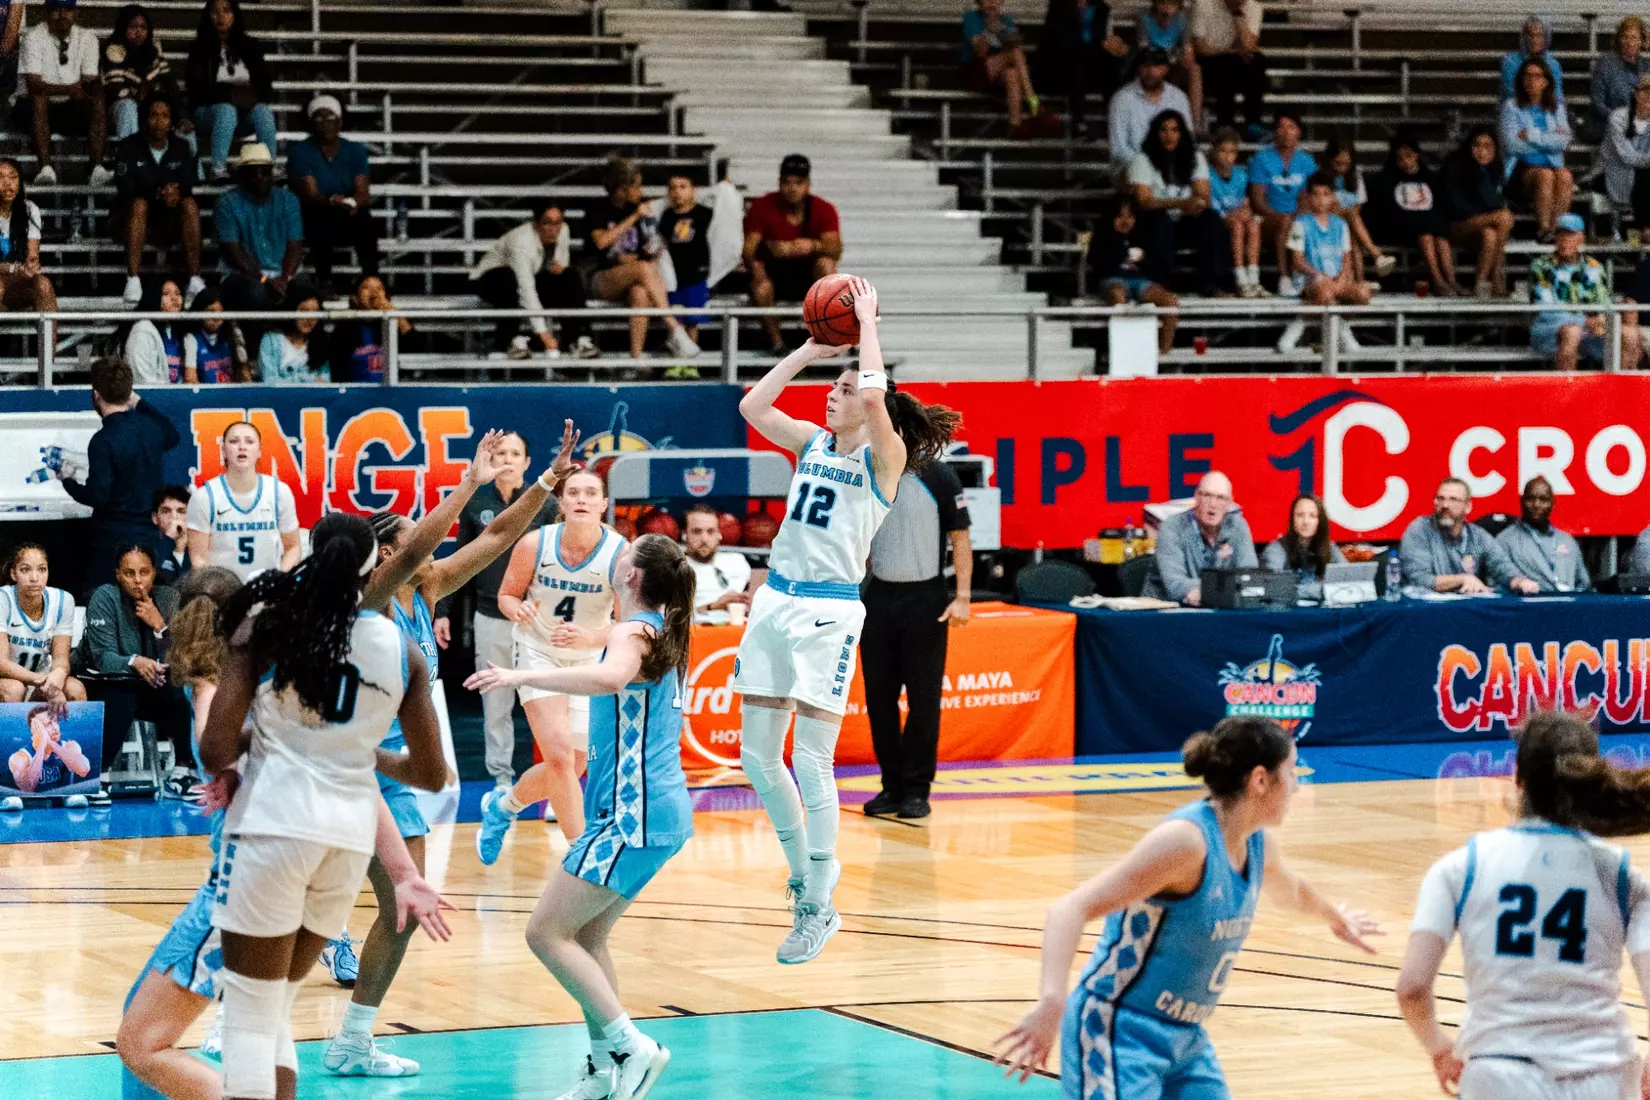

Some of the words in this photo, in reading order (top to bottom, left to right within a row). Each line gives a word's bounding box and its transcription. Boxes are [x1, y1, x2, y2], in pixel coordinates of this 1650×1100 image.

[790, 481, 836, 528] 12
[238, 536, 255, 565] 5
[537, 574, 603, 593] COLUMBIA
[553, 595, 576, 623] 4
[18, 651, 41, 673] 11
[832, 634, 855, 697] LIONS
[327, 662, 360, 724] 0
[957, 671, 1013, 691] MAYA
[1224, 682, 1317, 704] CANCUN
[965, 689, 1042, 708] EXPERIENCE
[1230, 704, 1310, 717] CHALLENGE
[1495, 883, 1588, 964] 24
